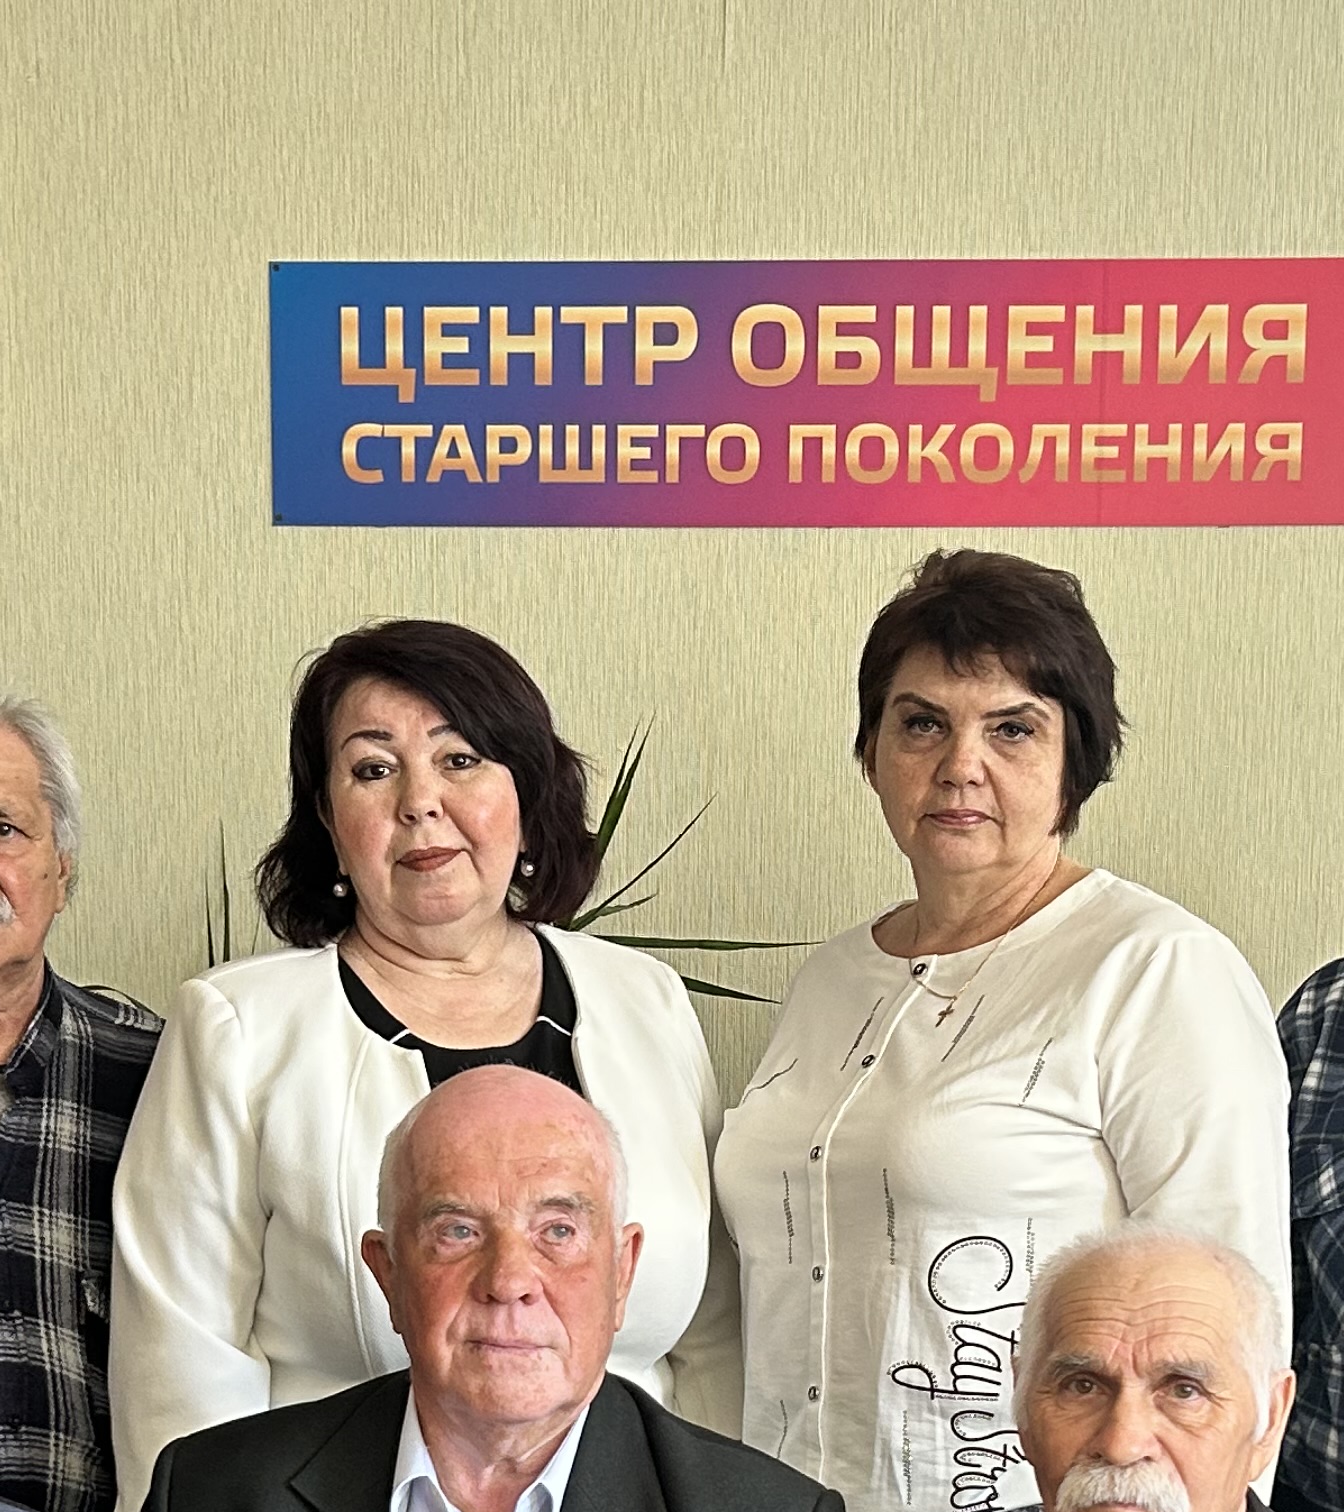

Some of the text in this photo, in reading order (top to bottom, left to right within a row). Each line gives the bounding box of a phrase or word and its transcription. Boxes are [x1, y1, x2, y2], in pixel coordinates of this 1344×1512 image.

[341, 303, 1308, 403] ЦЕНТР ОБЩЕНИЯ
[342, 422, 1304, 484] СТАРШЕГО ПОКОЛЕНИЯ
